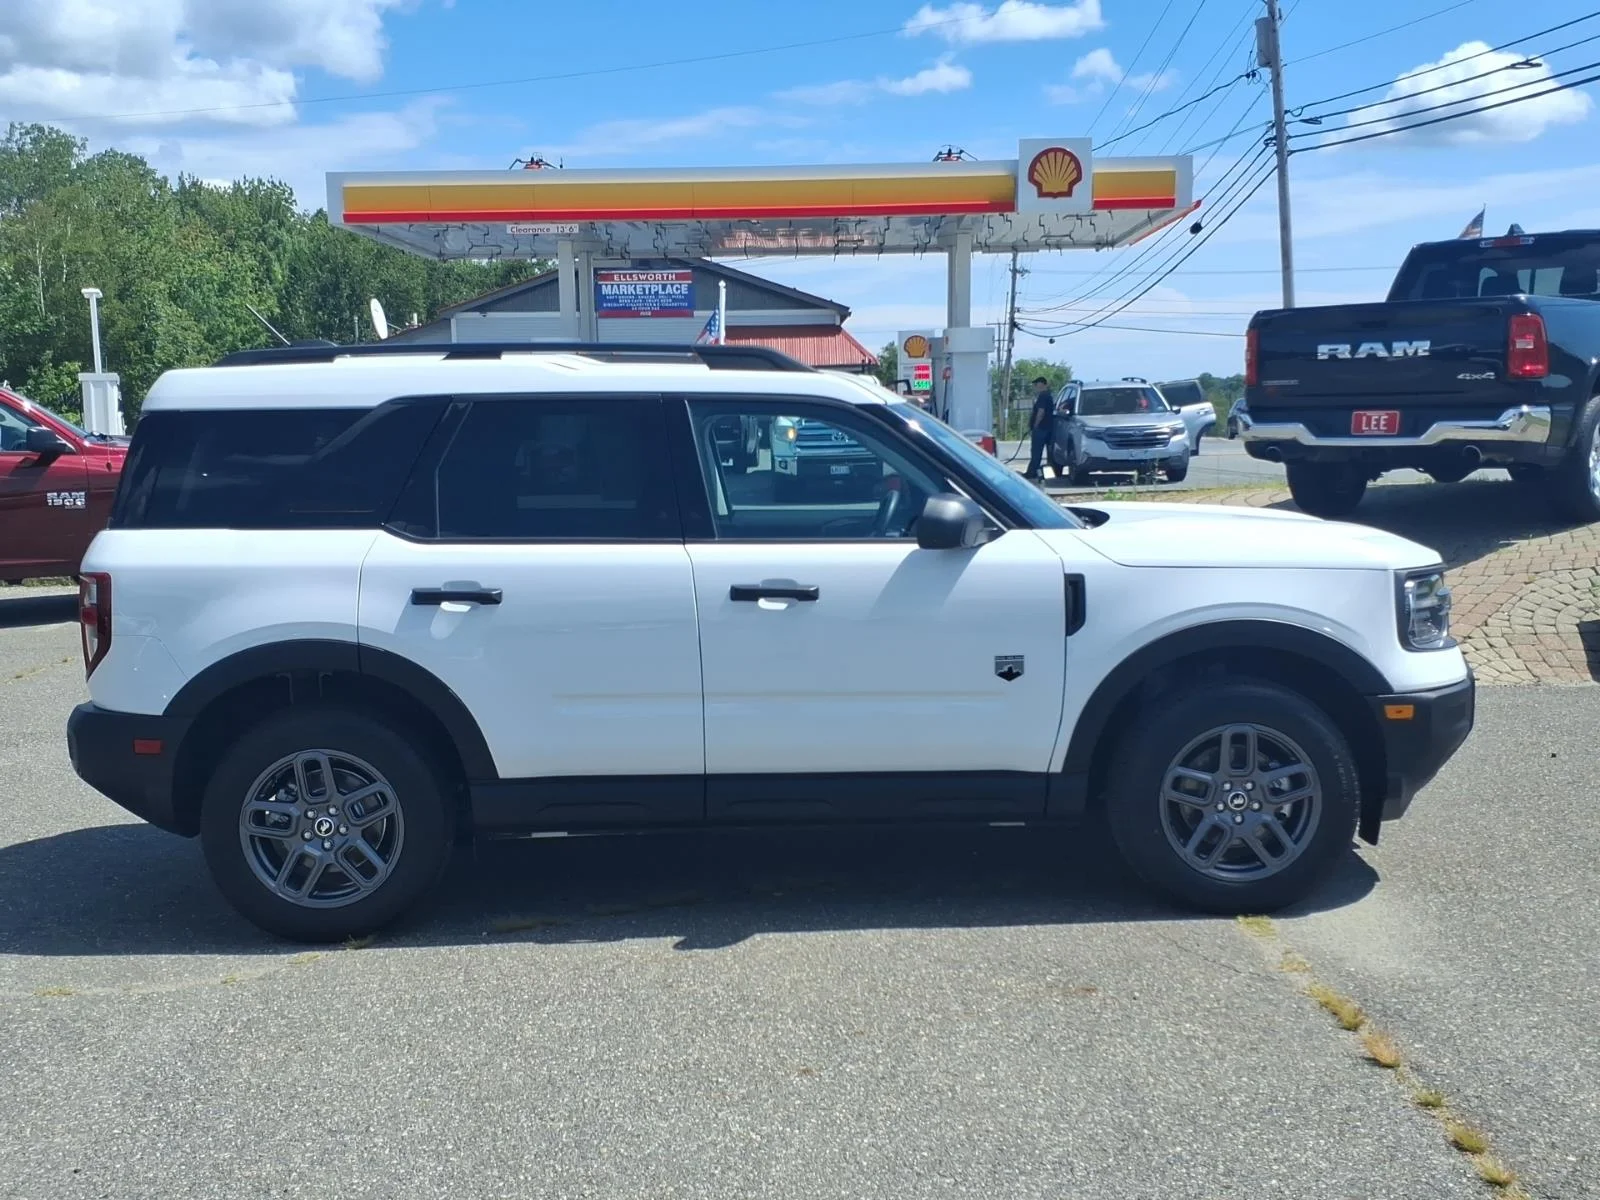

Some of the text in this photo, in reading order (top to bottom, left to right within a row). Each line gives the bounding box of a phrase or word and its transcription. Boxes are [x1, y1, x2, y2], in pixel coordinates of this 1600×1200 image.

[510, 225, 551, 233] Clearance
[613, 273, 676, 281] ELLSWORTH
[602, 284, 689, 295] MARKETPLACE
[1317, 340, 1431, 360] RAM
[1362, 415, 1389, 430] LEE
[46, 492, 86, 500] RAM
